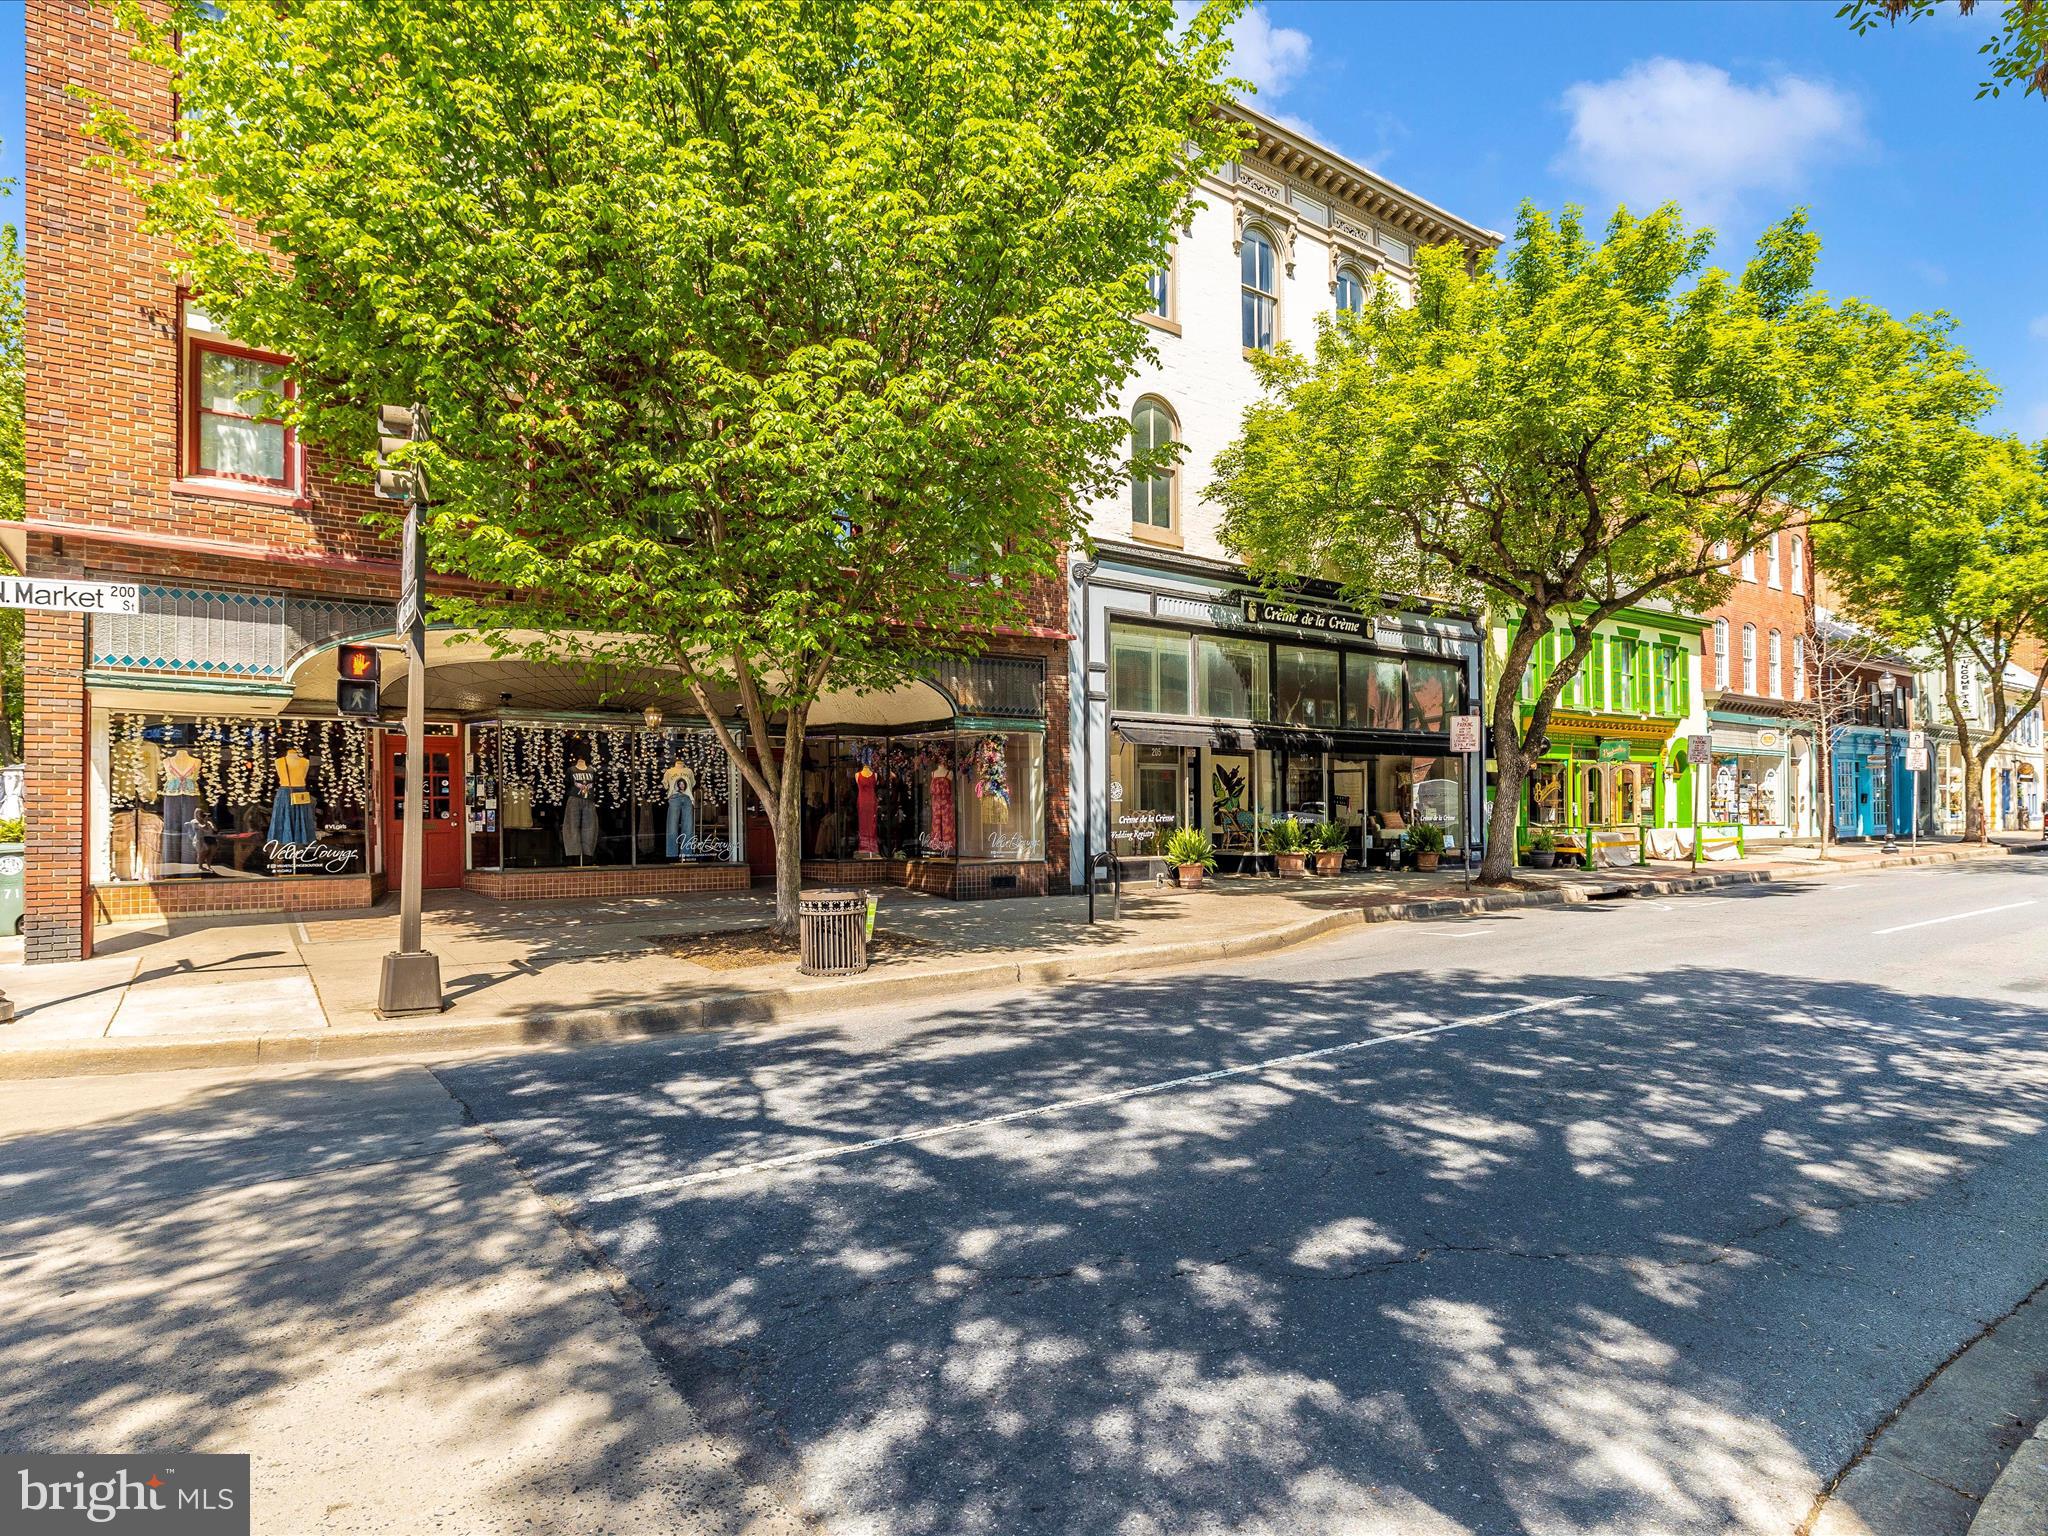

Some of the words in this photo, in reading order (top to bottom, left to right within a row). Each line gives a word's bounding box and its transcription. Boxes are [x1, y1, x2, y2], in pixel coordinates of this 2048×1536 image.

[15, 582, 104, 608] Market
[110, 586, 136, 598] 200
[122, 600, 135, 612] St
[1264, 606, 1299, 623] Crème
[1301, 613, 1313, 626] de
[1314, 615, 1326, 627] la
[1328, 616, 1360, 632] Crème
[1960, 660, 1970, 690] INCOME
[262, 839, 317, 863] Velvet
